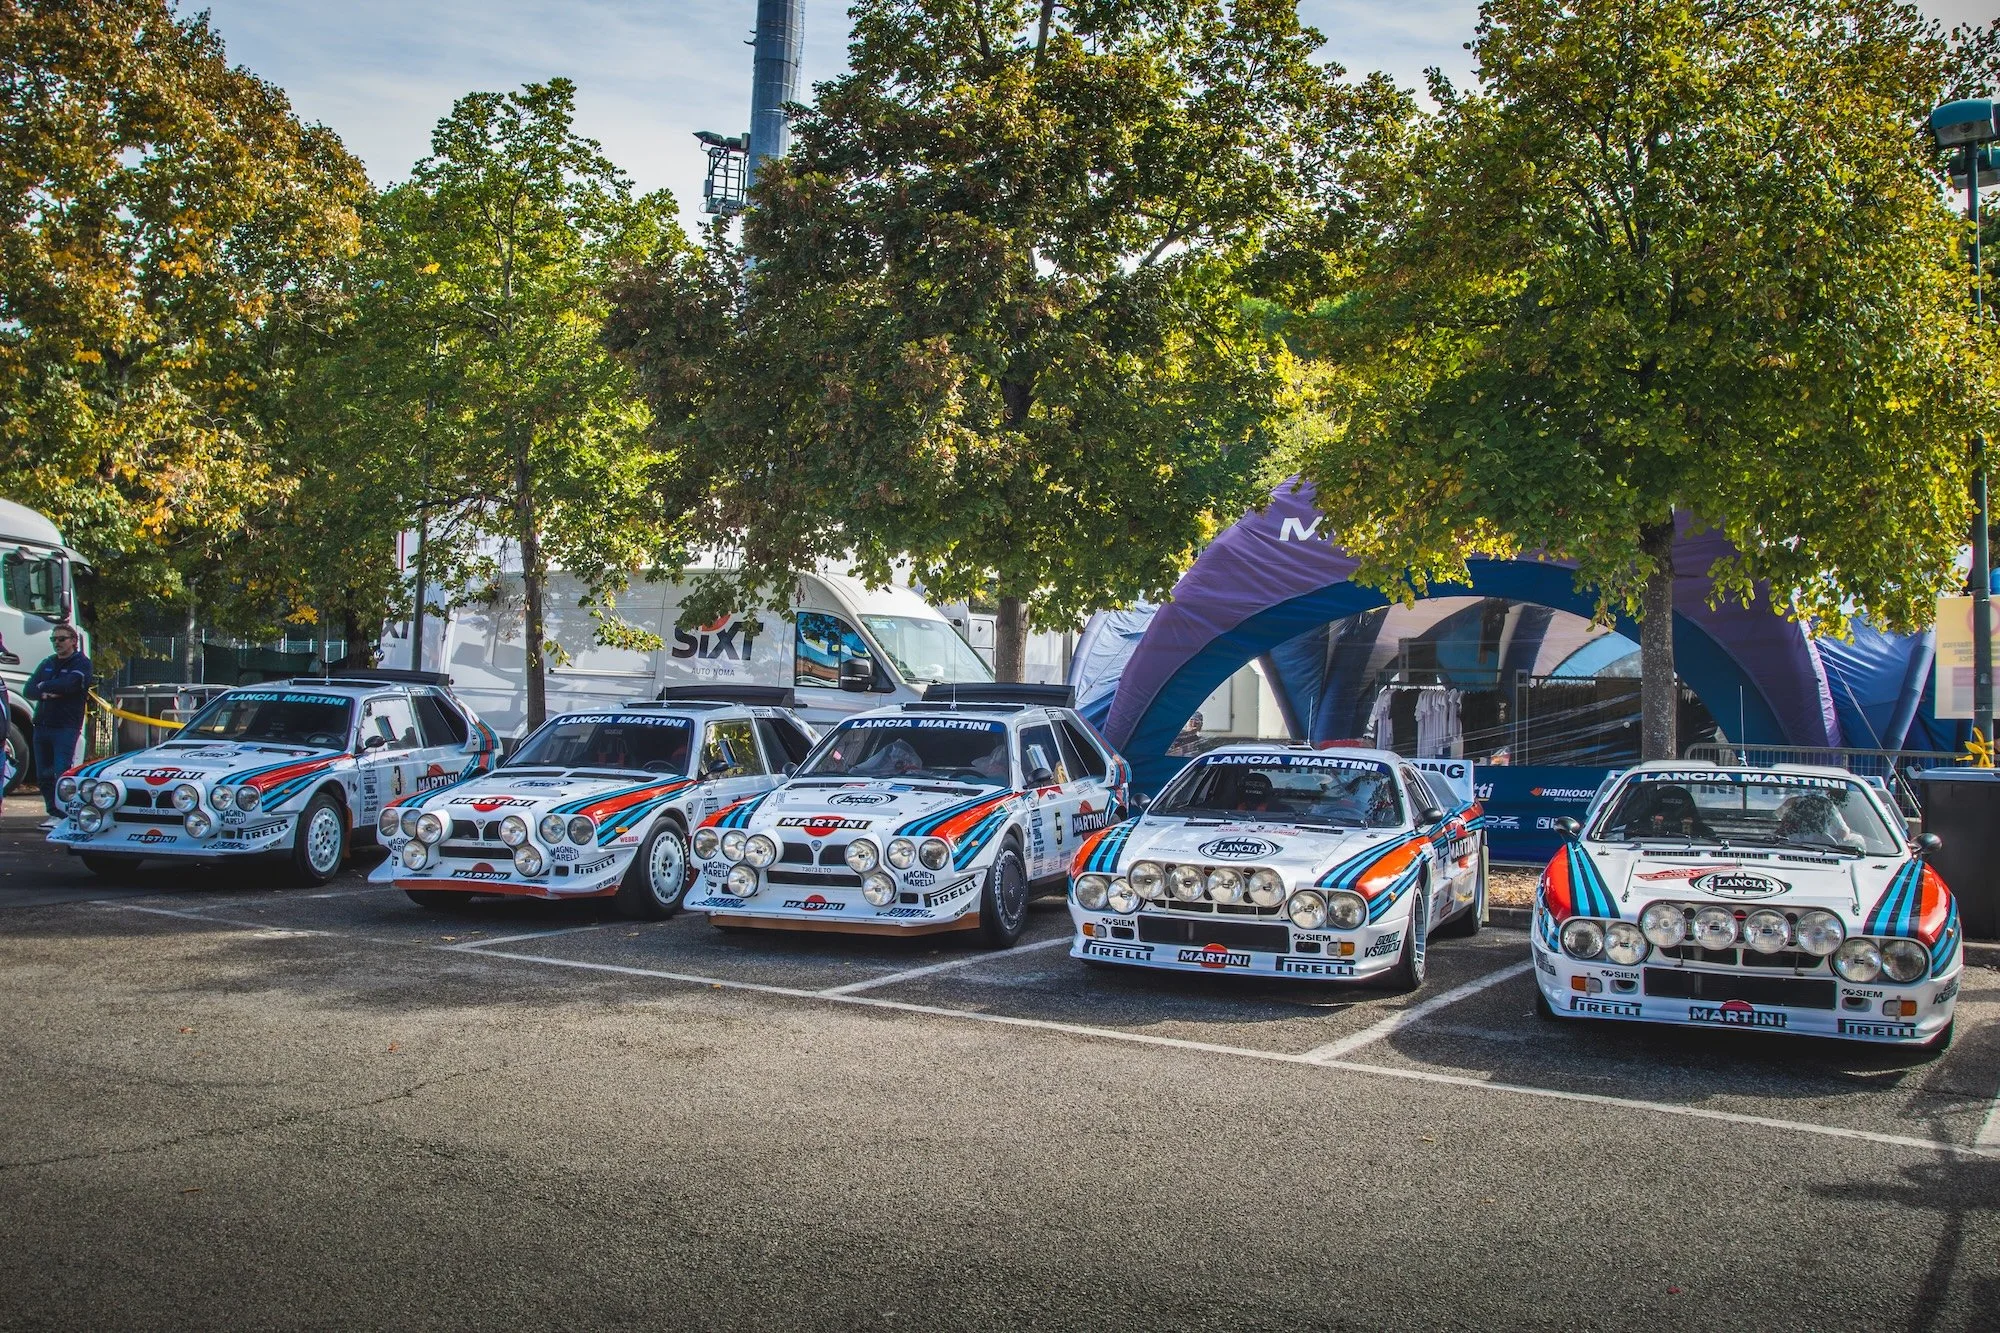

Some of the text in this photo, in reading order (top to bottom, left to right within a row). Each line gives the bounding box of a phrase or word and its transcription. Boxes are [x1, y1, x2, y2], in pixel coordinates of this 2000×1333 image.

[691, 667, 735, 678] AUTO NOMA
[227, 693, 347, 706] LANCIA MARTINI
[557, 716, 686, 728] LANCIA MARTINI
[851, 719, 991, 731] LANCIA MARTINI
[1206, 756, 1282, 765] LANCIA
[1289, 756, 1379, 772] MARTINI
[123, 769, 203, 780] MARTINI
[394, 765, 401, 795] 3
[1640, 772, 1732, 782] LANCIA
[1741, 773, 1847, 790] MARTINI
[418, 773, 459, 792] MARTINI
[453, 797, 534, 807] MARTINI
[237, 819, 289, 840] PIRELLI
[781, 817, 868, 830] MARTINI
[1055, 812, 1062, 845] 5
[1072, 813, 1105, 834] MARTINI
[129, 834, 177, 843] MARTINI
[1219, 844, 1259, 853] LANCIA
[574, 854, 616, 874] PIRELLI
[703, 861, 731, 871] MAGNET
[454, 871, 508, 880] MARTINI
[903, 870, 935, 880] MAGNETI
[1716, 878, 1767, 889] LANCIA
[923, 874, 977, 907] PIRELLI
[785, 901, 844, 910] MARTINI
[1112, 918, 1135, 927] SIEM
[1306, 933, 1331, 942] SIEM
[1083, 939, 1154, 961] PIRELLI
[1180, 951, 1248, 965] MARTINI
[1275, 956, 1356, 975] PIRELLI
[1614, 972, 1640, 980] SIEM
[1855, 989, 1883, 998] SIEM
[1570, 996, 1642, 1016] PIRELLI
[1692, 1007, 1783, 1026] MARTINI
[1838, 1019, 1917, 1038] PIRELLI
